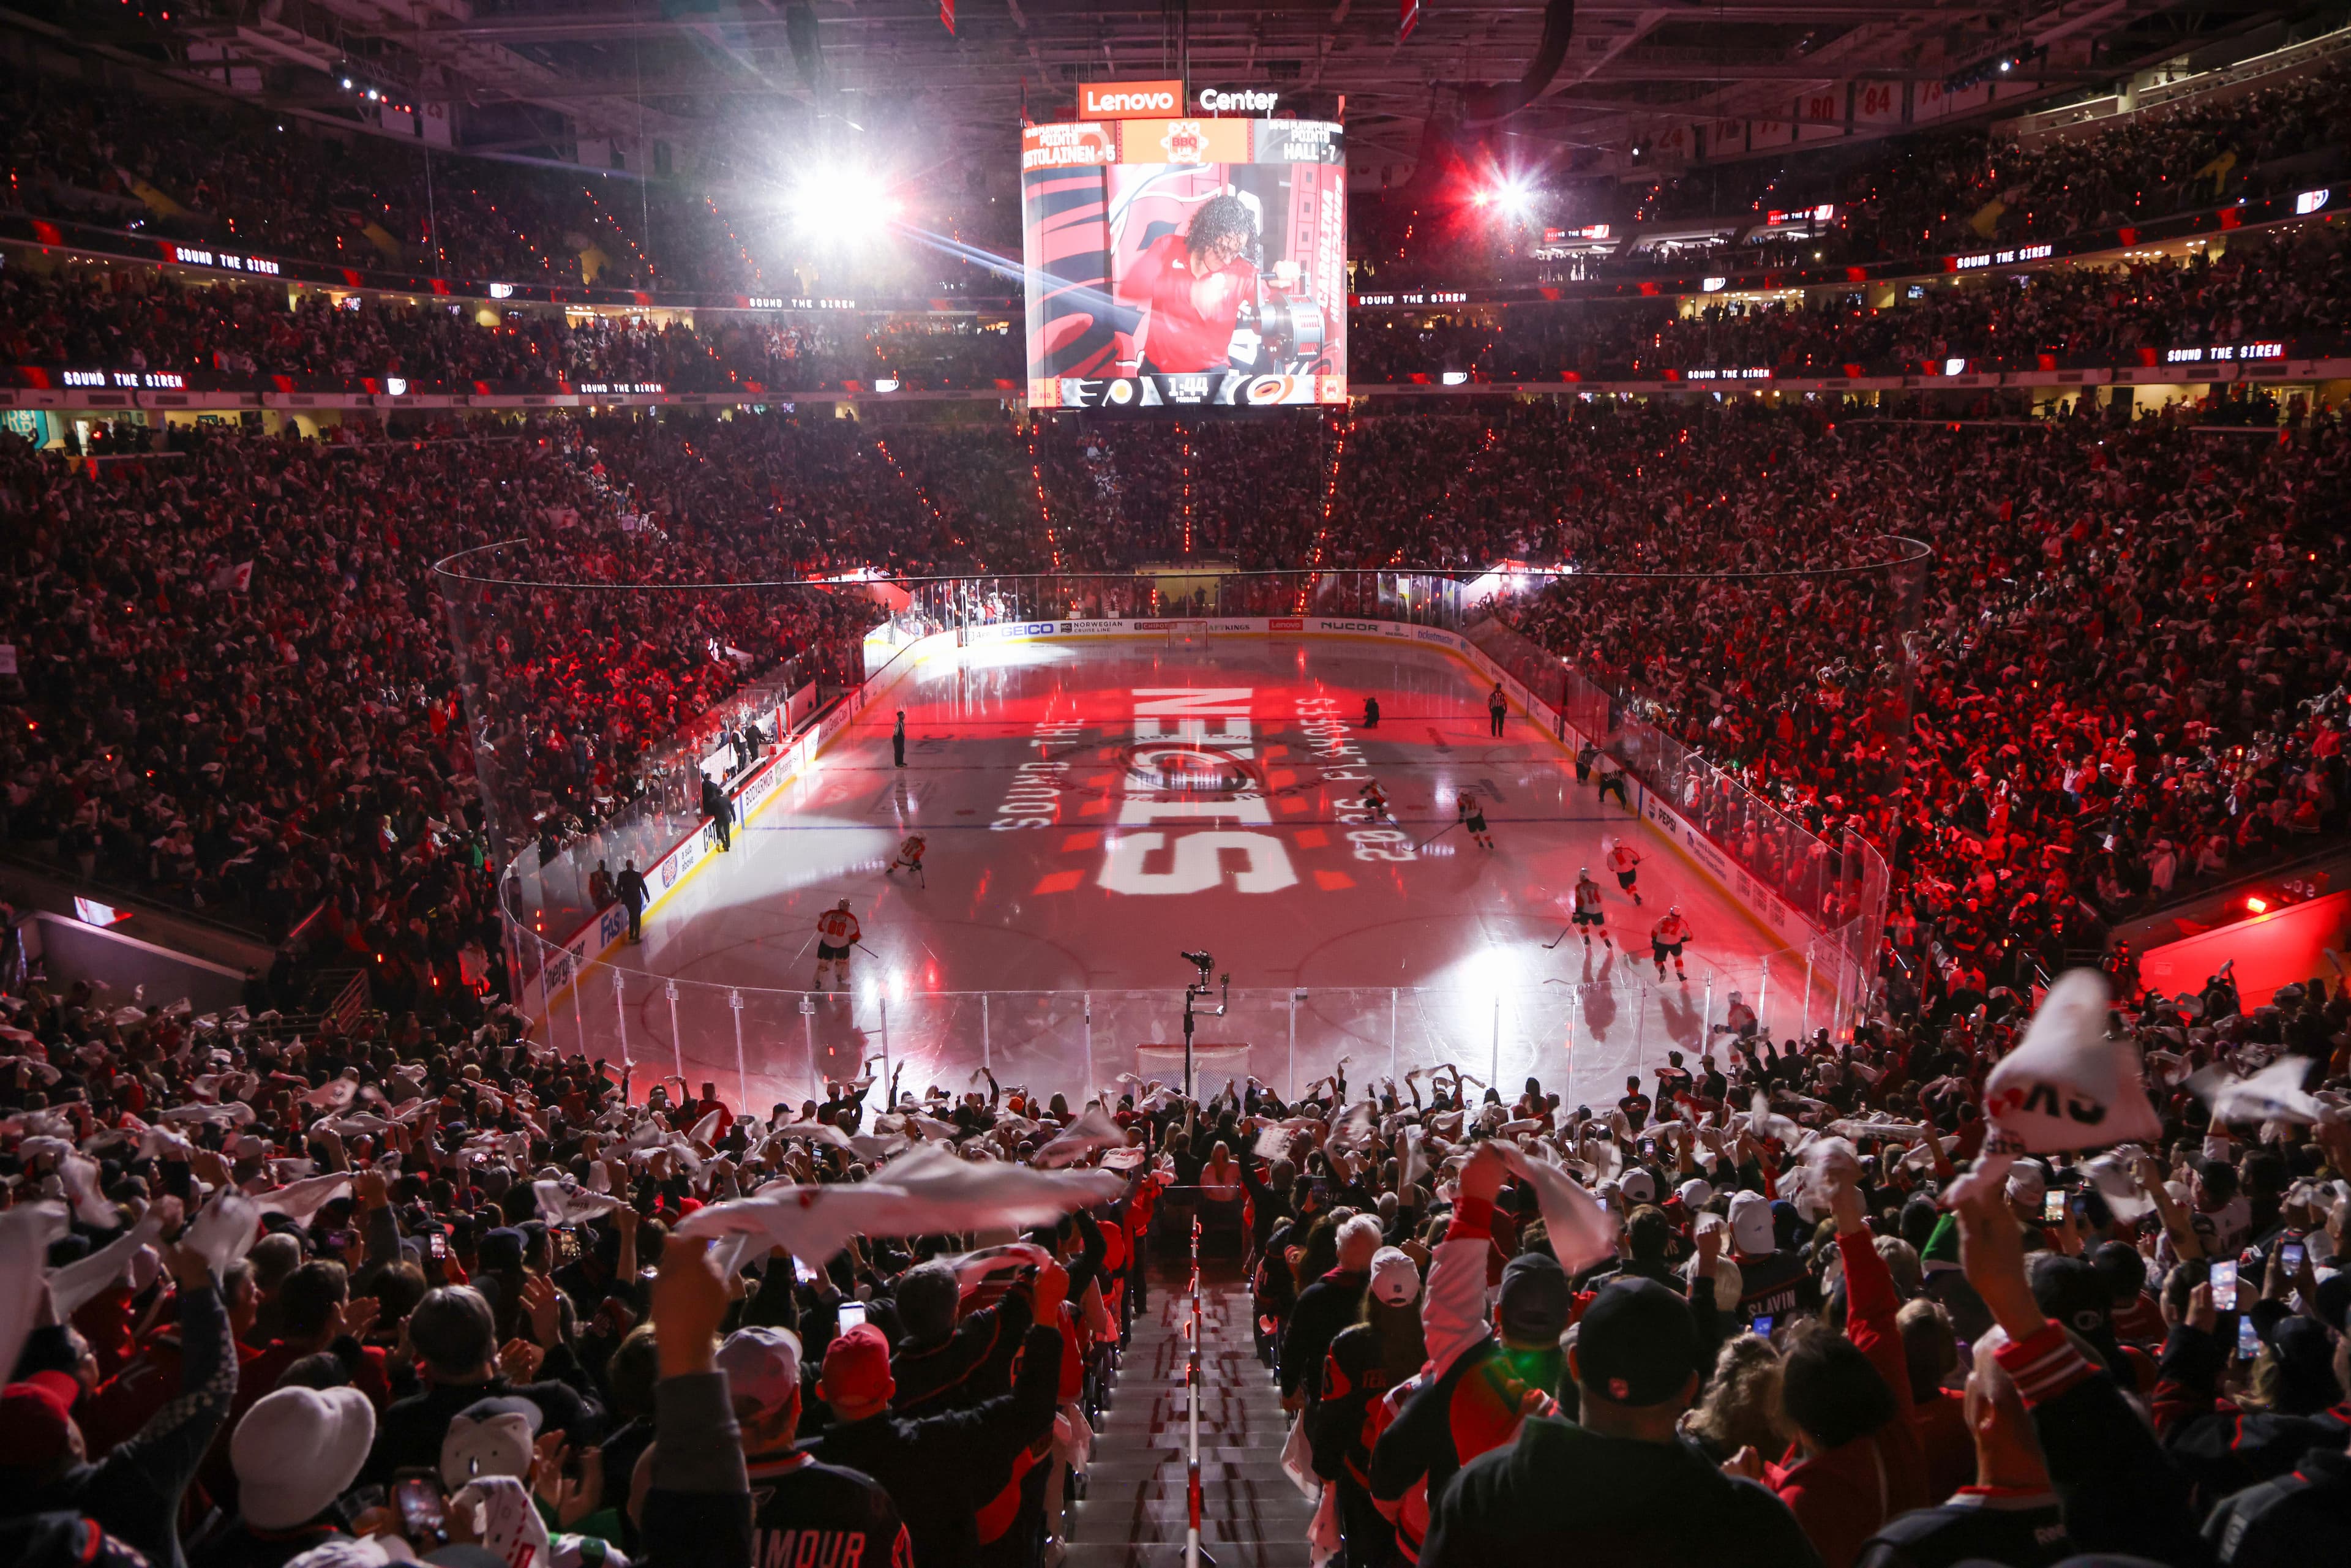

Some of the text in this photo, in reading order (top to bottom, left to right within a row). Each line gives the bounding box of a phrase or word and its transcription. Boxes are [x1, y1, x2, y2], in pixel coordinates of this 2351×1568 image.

[1087, 88, 1278, 112] Lenovo Center
[1810, 96, 1834, 119] 80
[1865, 86, 1891, 115] 84
[1040, 133, 1079, 146] POINTS
[1172, 137, 1198, 148] BBQ
[1291, 130, 1330, 143] POINTS
[1106, 144, 1116, 162] 5
[1284, 143, 1319, 160] HALL
[1328, 144, 1336, 162] 7
[1317, 189, 1333, 309] CAROLINA
[1957, 245, 2052, 269] SOUND THE SIREN
[176, 247, 279, 275] SOUND THE SIREN
[749, 298, 855, 309] SOUND THE SIREN
[1359, 293, 1466, 305] SOUND THE SIREN
[2167, 343, 2282, 362] SOUND THE SIREN
[64, 371, 183, 388] SOUND THE SIREN
[1688, 369, 1769, 379] SOUND THE SIREN
[580, 383, 662, 392] SOUND THE SIREN
[1168, 377, 1209, 397] 1:44
[1002, 623, 1054, 637] GEICO
[1321, 621, 1378, 632] NUCOR
[989, 718, 1085, 831] SOUND THE
[745, 770, 774, 806] BODYARMOR
[1097, 688, 1299, 895] SIREN
[1658, 808, 1676, 834] PEPSI
[1660, 920, 1681, 936] 27
[1748, 1289, 1796, 1317] SLAVIN
